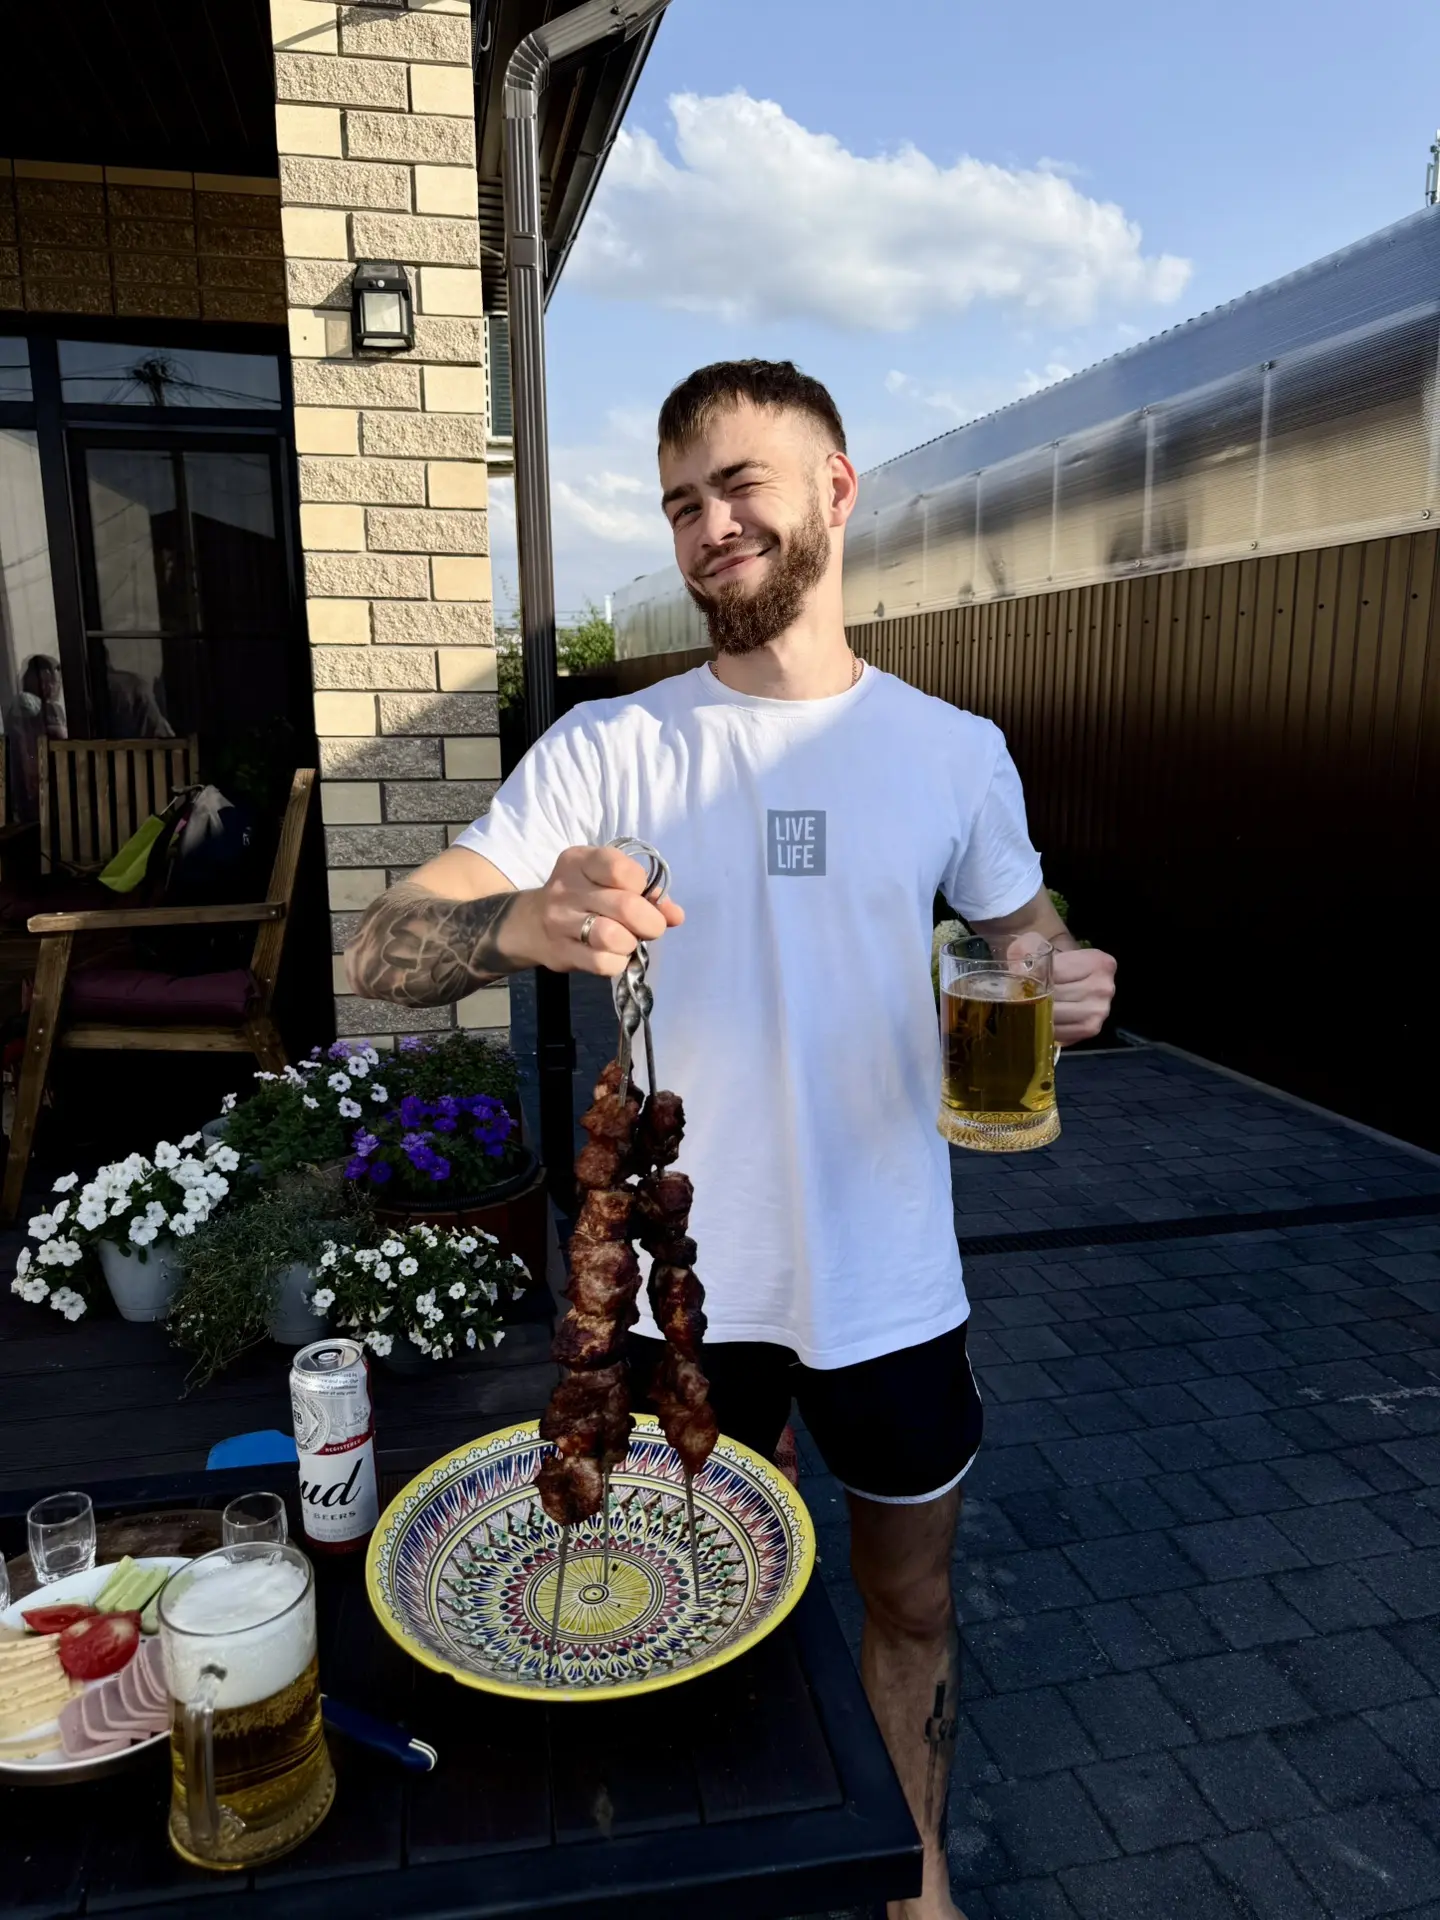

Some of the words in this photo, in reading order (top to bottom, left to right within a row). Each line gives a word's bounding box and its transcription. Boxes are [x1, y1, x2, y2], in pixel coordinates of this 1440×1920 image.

[775, 816, 816, 842] LIVE
[777, 844, 815, 869] LIFE
[300, 1457, 363, 1507] ud
[313, 1511, 356, 1520] BEERS
